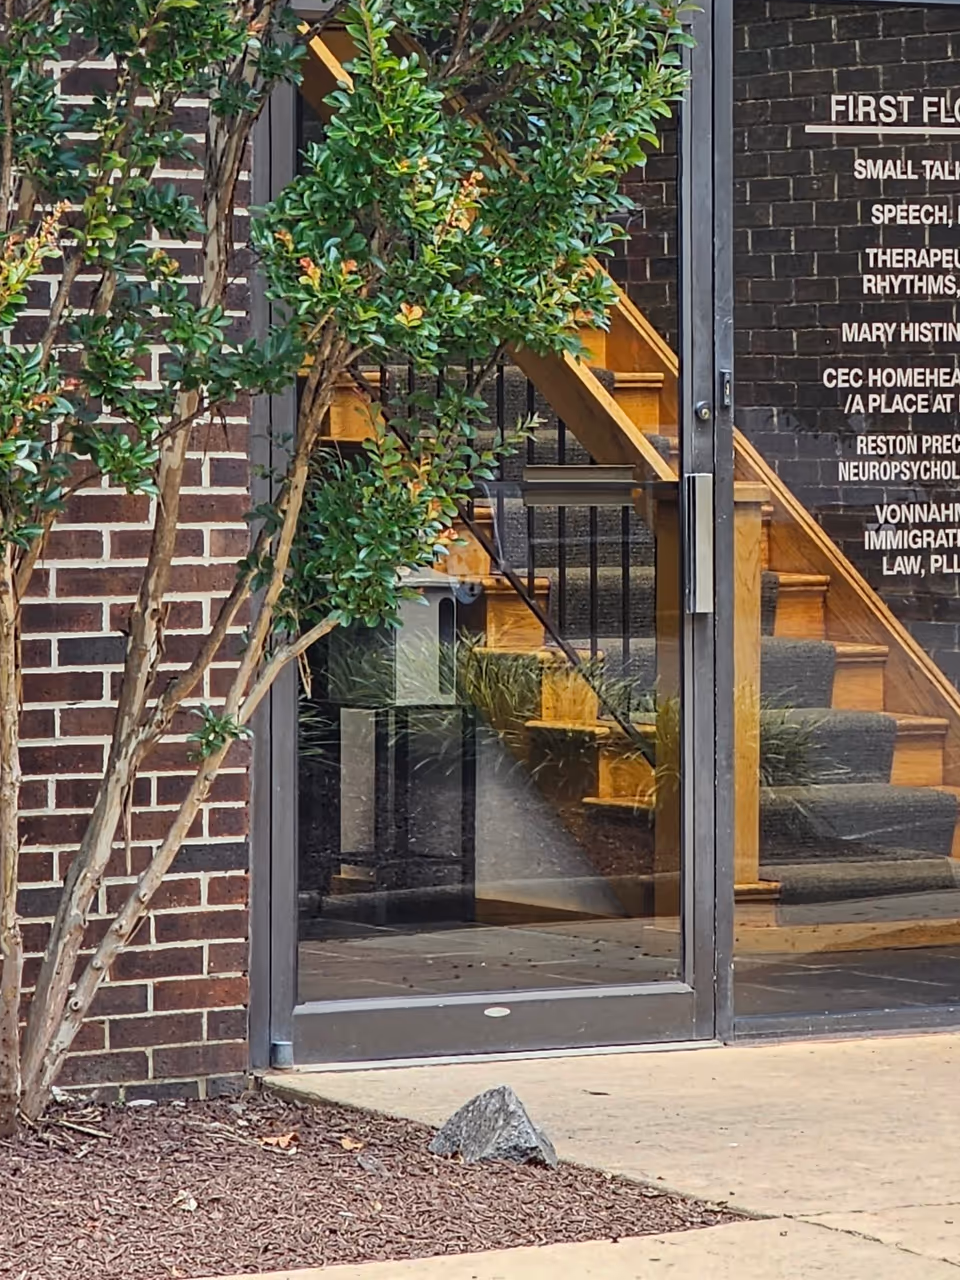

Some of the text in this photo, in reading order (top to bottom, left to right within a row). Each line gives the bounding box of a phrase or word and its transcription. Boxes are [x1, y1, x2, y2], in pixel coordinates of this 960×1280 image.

[831, 94, 914, 123] FIRST
[853, 158, 918, 180] SMALL
[871, 204, 952, 228] SPEECH,
[862, 274, 960, 298] RHYTHMS,
[842, 322, 897, 343] MARY
[822, 367, 863, 388] CEC
[844, 393, 865, 414] /A
[868, 393, 929, 414] PLACE
[932, 393, 955, 413] AT
[856, 435, 918, 455] RESTON
[882, 555, 925, 578] LAW,
